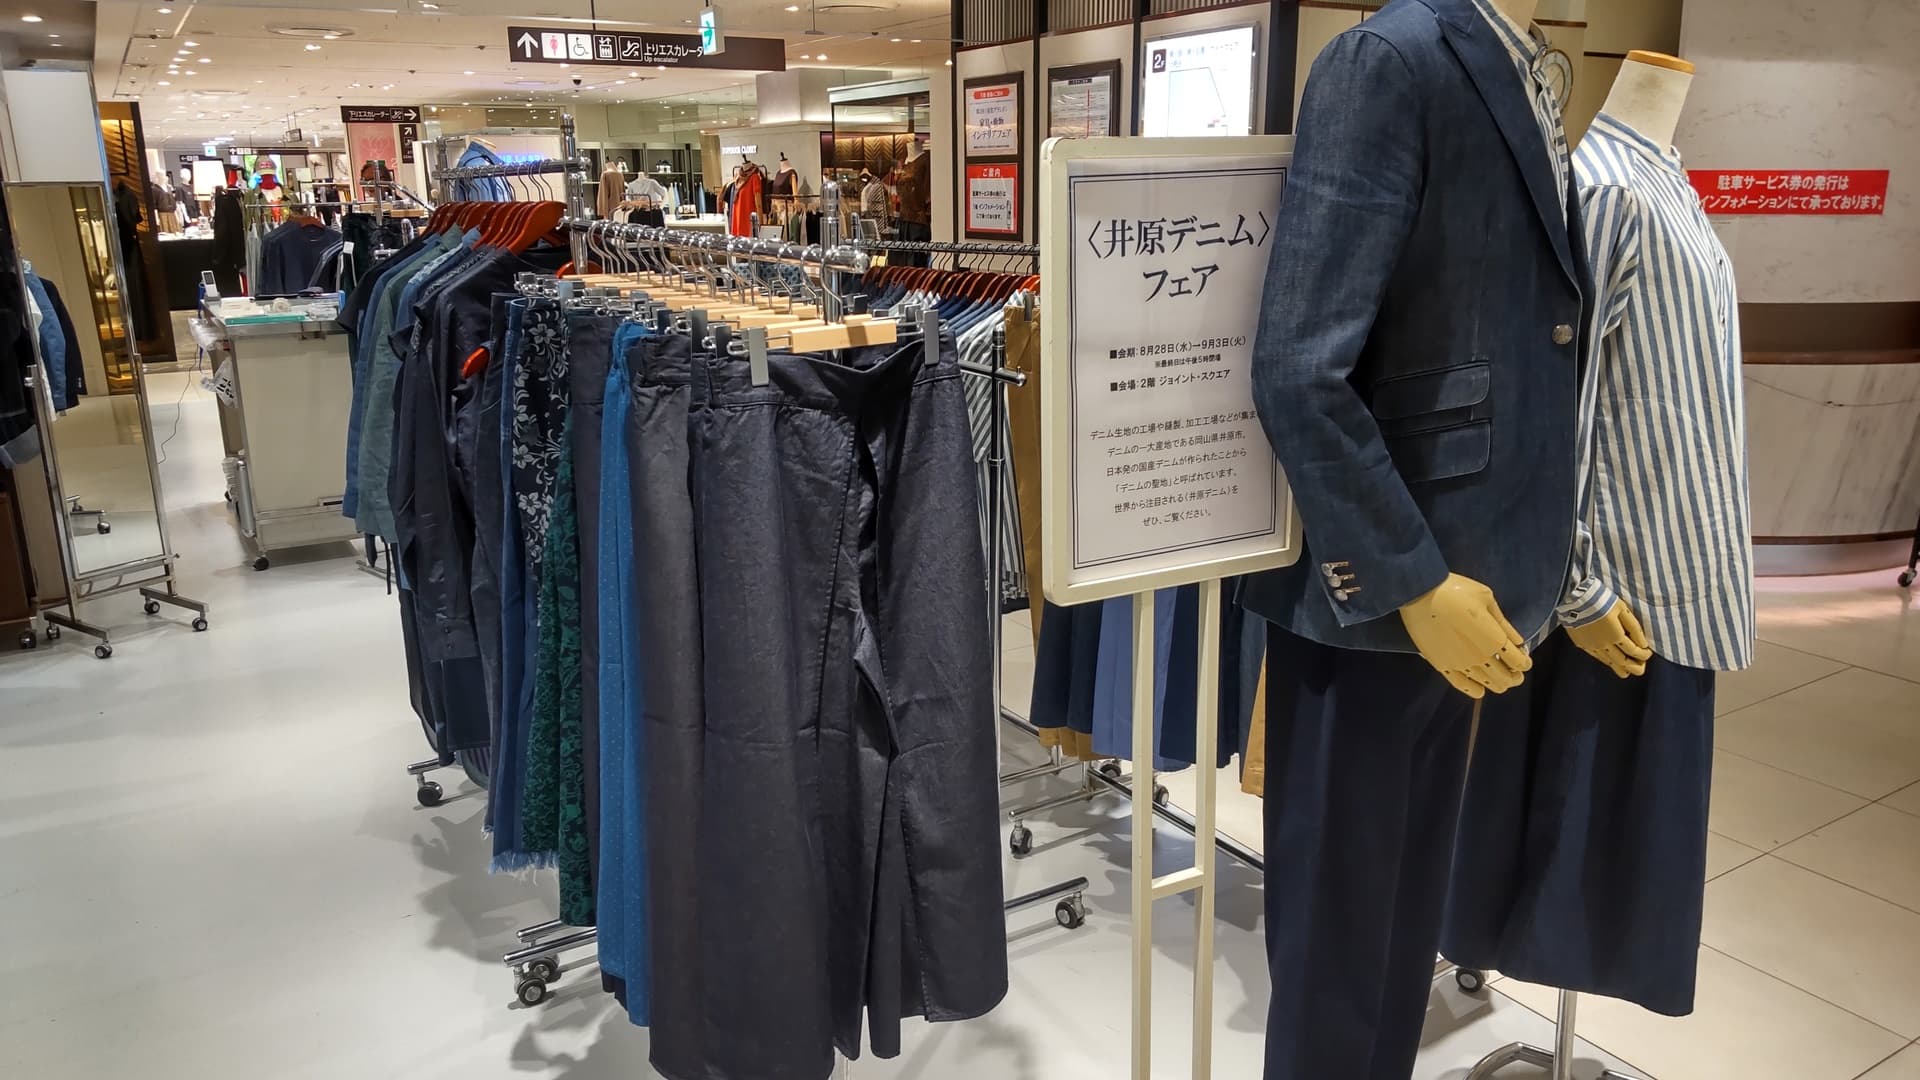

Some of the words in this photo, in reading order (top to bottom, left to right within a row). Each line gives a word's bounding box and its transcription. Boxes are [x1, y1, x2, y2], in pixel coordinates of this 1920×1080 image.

[983, 168, 1001, 177] ご案内
[1717, 175, 1849, 191] 駐車サービス券の発行は
[1142, 263, 1220, 303] フェア
[1107, 447, 1247, 476] 日本発の国産デニムが作られたことから
[1143, 508, 1212, 526] ぜひ、ご覧ください。
